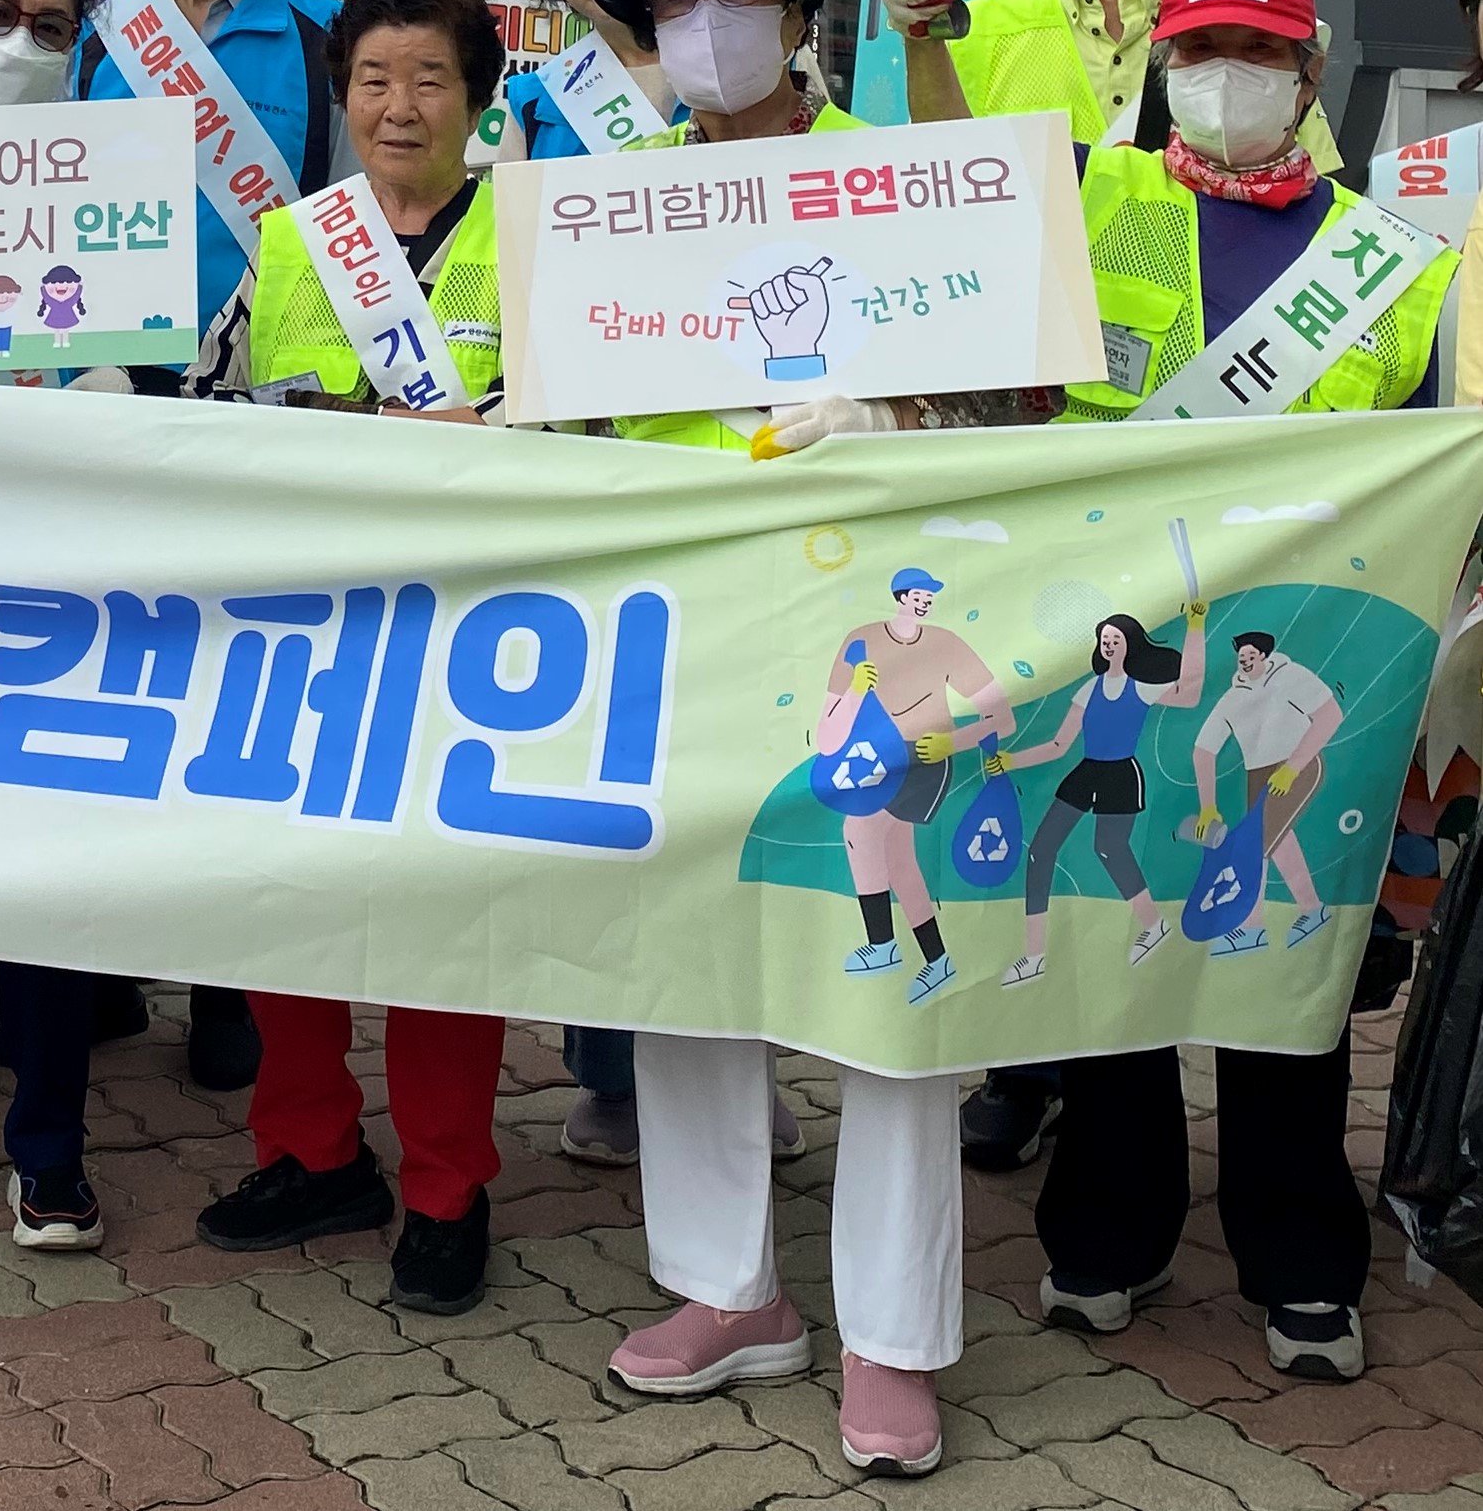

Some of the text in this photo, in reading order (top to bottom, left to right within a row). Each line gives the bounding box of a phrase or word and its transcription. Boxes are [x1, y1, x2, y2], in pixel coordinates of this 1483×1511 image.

[73, 199, 173, 252] 안산
[551, 156, 1016, 242] 우리함께 금연해요
[588, 301, 745, 342] 담배 OUT
[852, 269, 982, 325] 건강 IN
